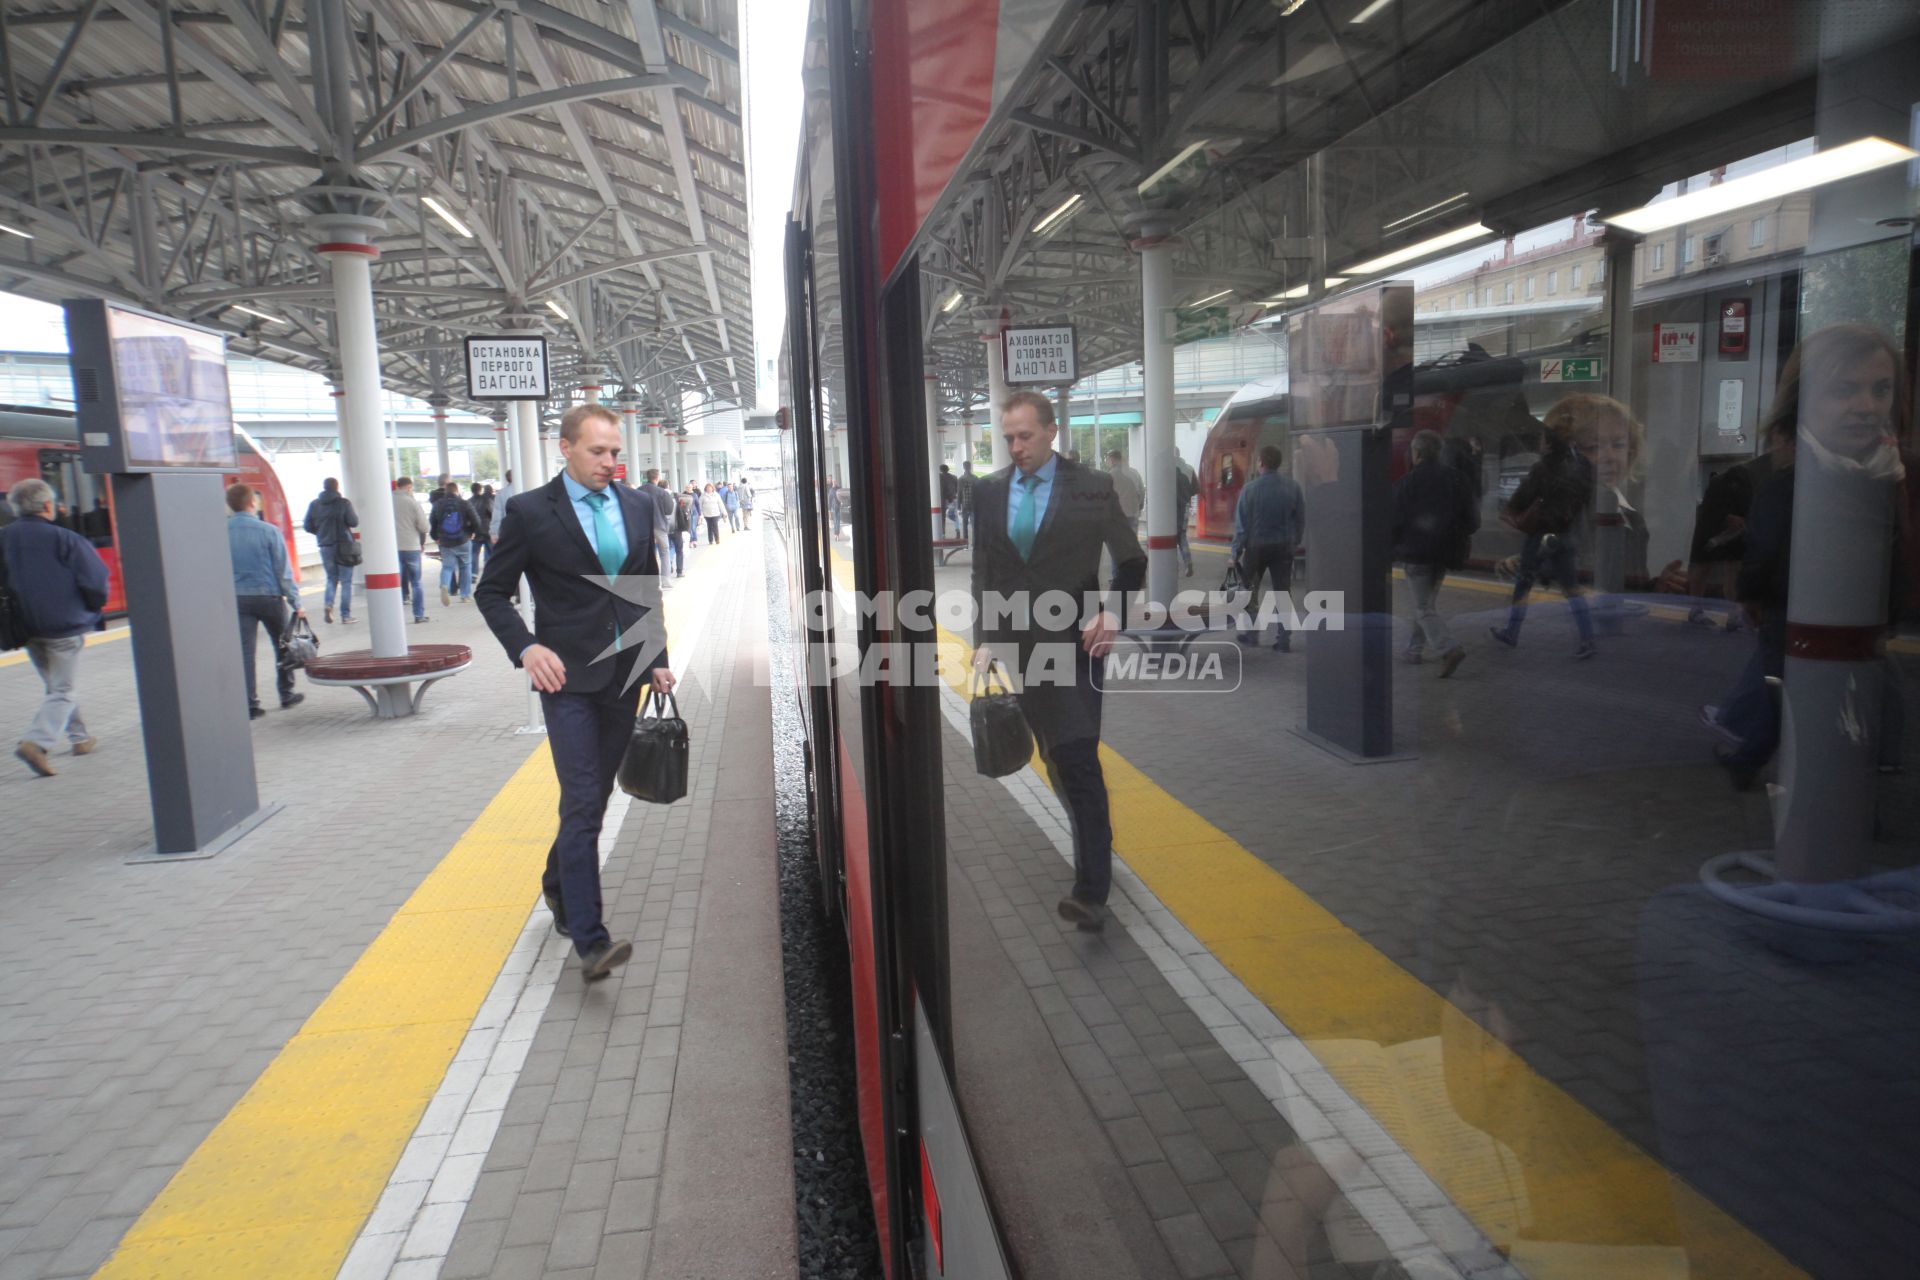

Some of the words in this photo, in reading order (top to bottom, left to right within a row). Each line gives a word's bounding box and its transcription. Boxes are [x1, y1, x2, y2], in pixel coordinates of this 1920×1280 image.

[473, 346, 541, 358] ОСТАНОВКА
[481, 361, 533, 372] ПЕРВОГО
[479, 374, 538, 390] ВАГОНА
